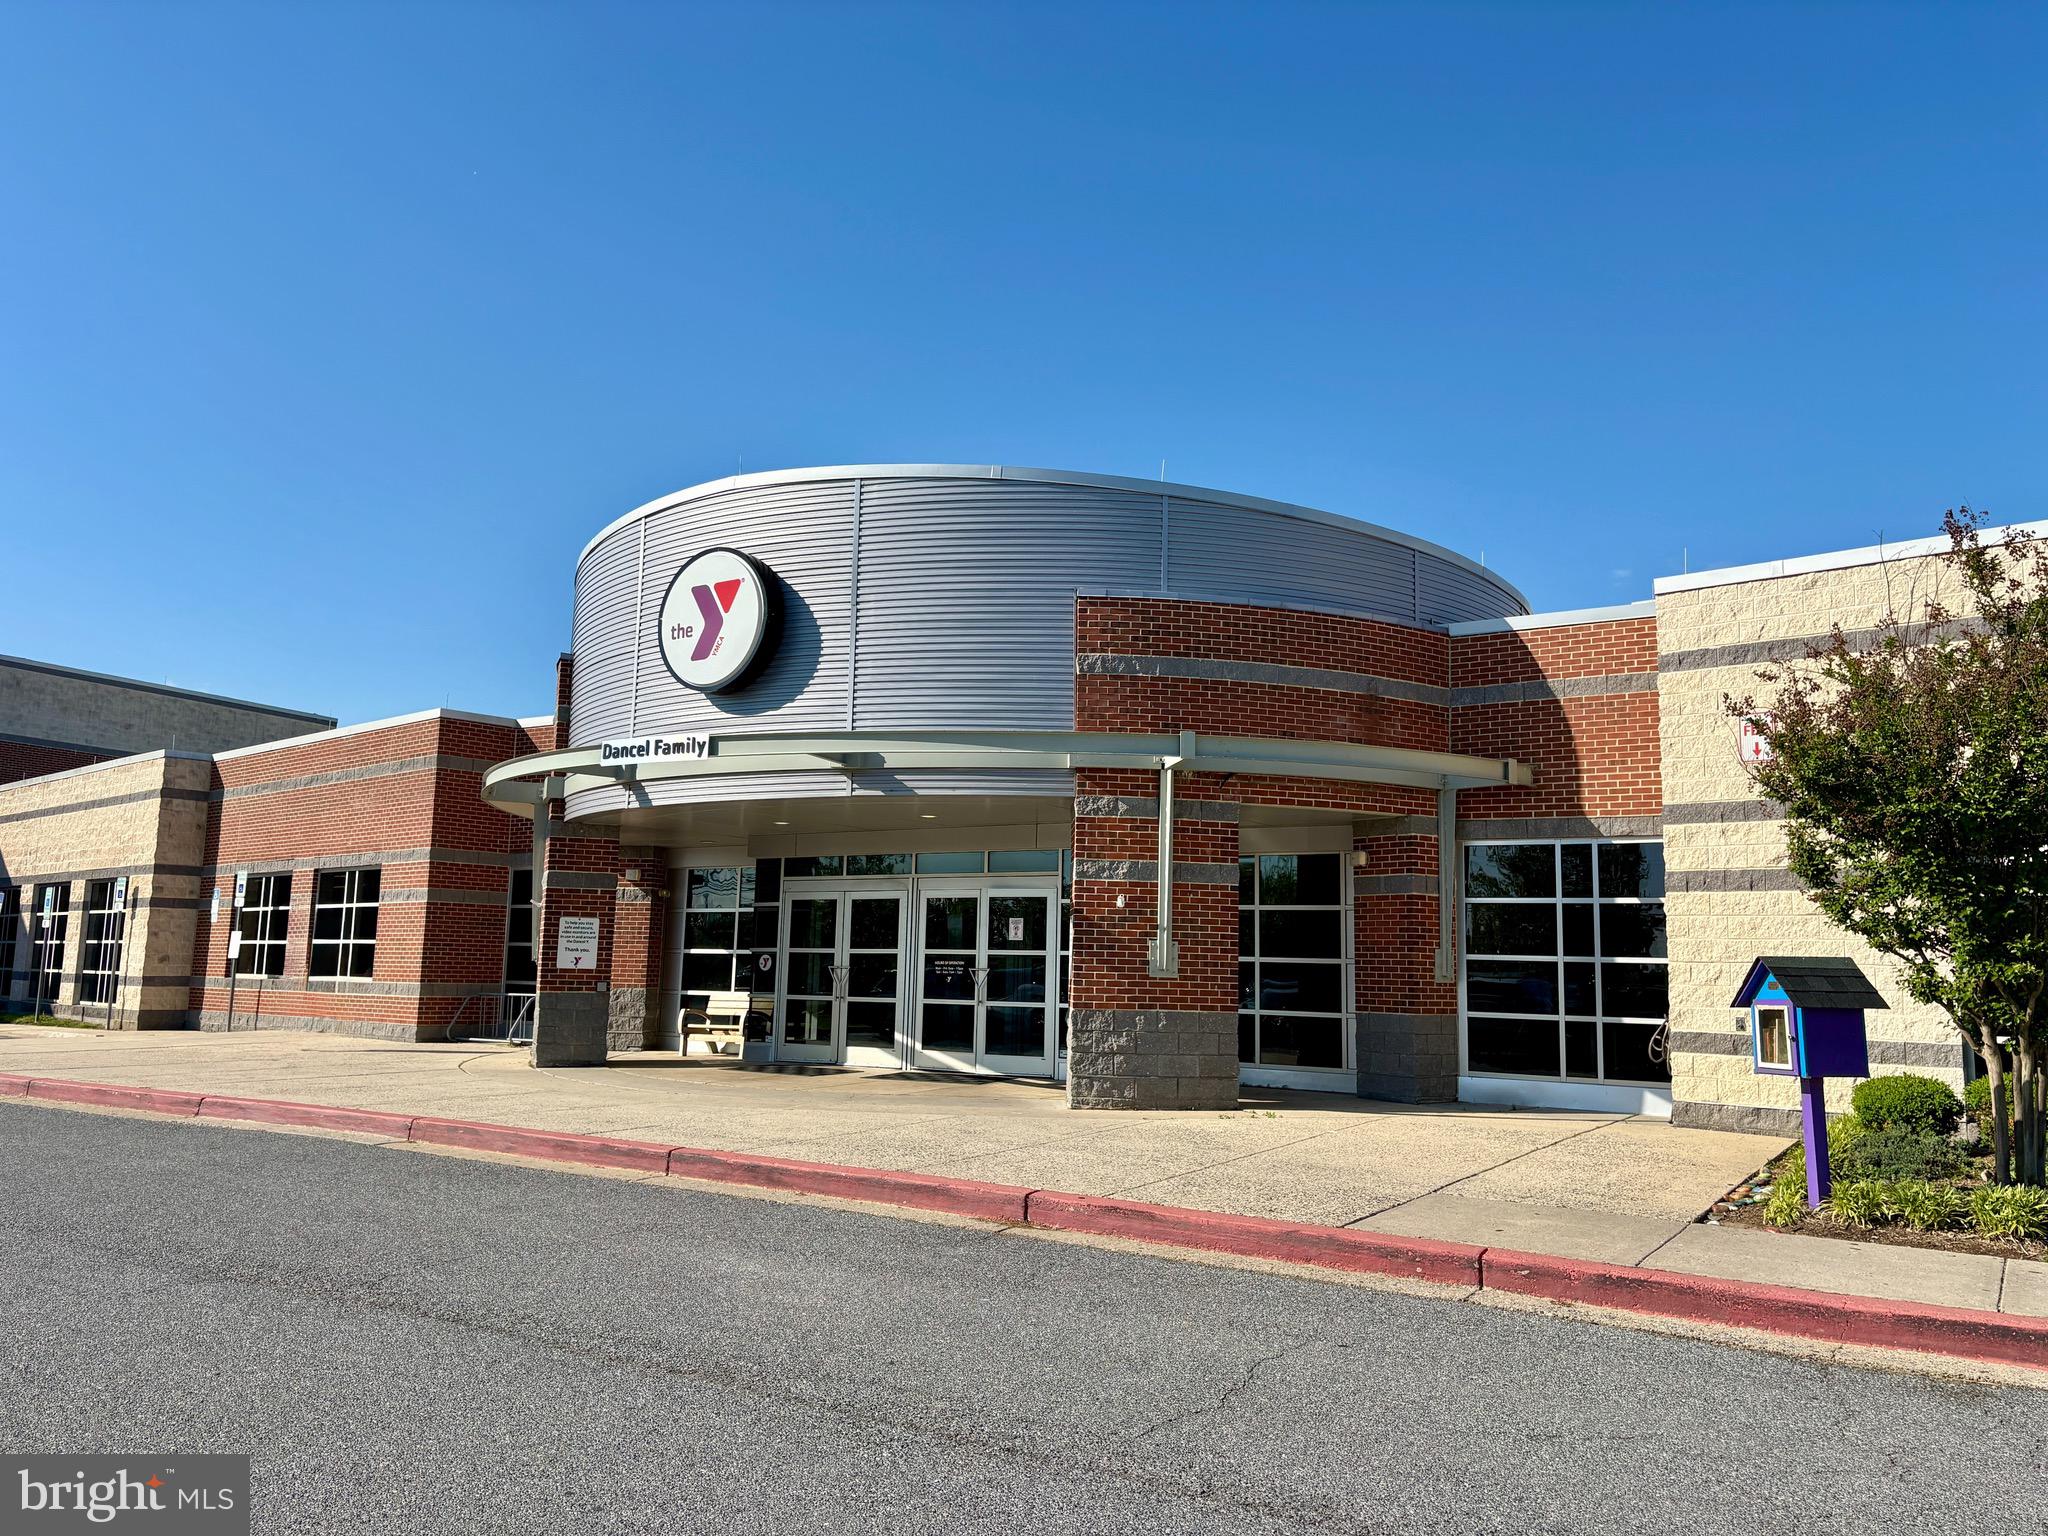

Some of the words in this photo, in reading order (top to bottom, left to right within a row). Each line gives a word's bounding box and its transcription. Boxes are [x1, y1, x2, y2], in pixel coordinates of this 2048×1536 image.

[671, 623, 693, 640] the
[711, 636, 725, 656] YMCA
[602, 739, 650, 760] Dancel
[654, 736, 707, 758] Family
